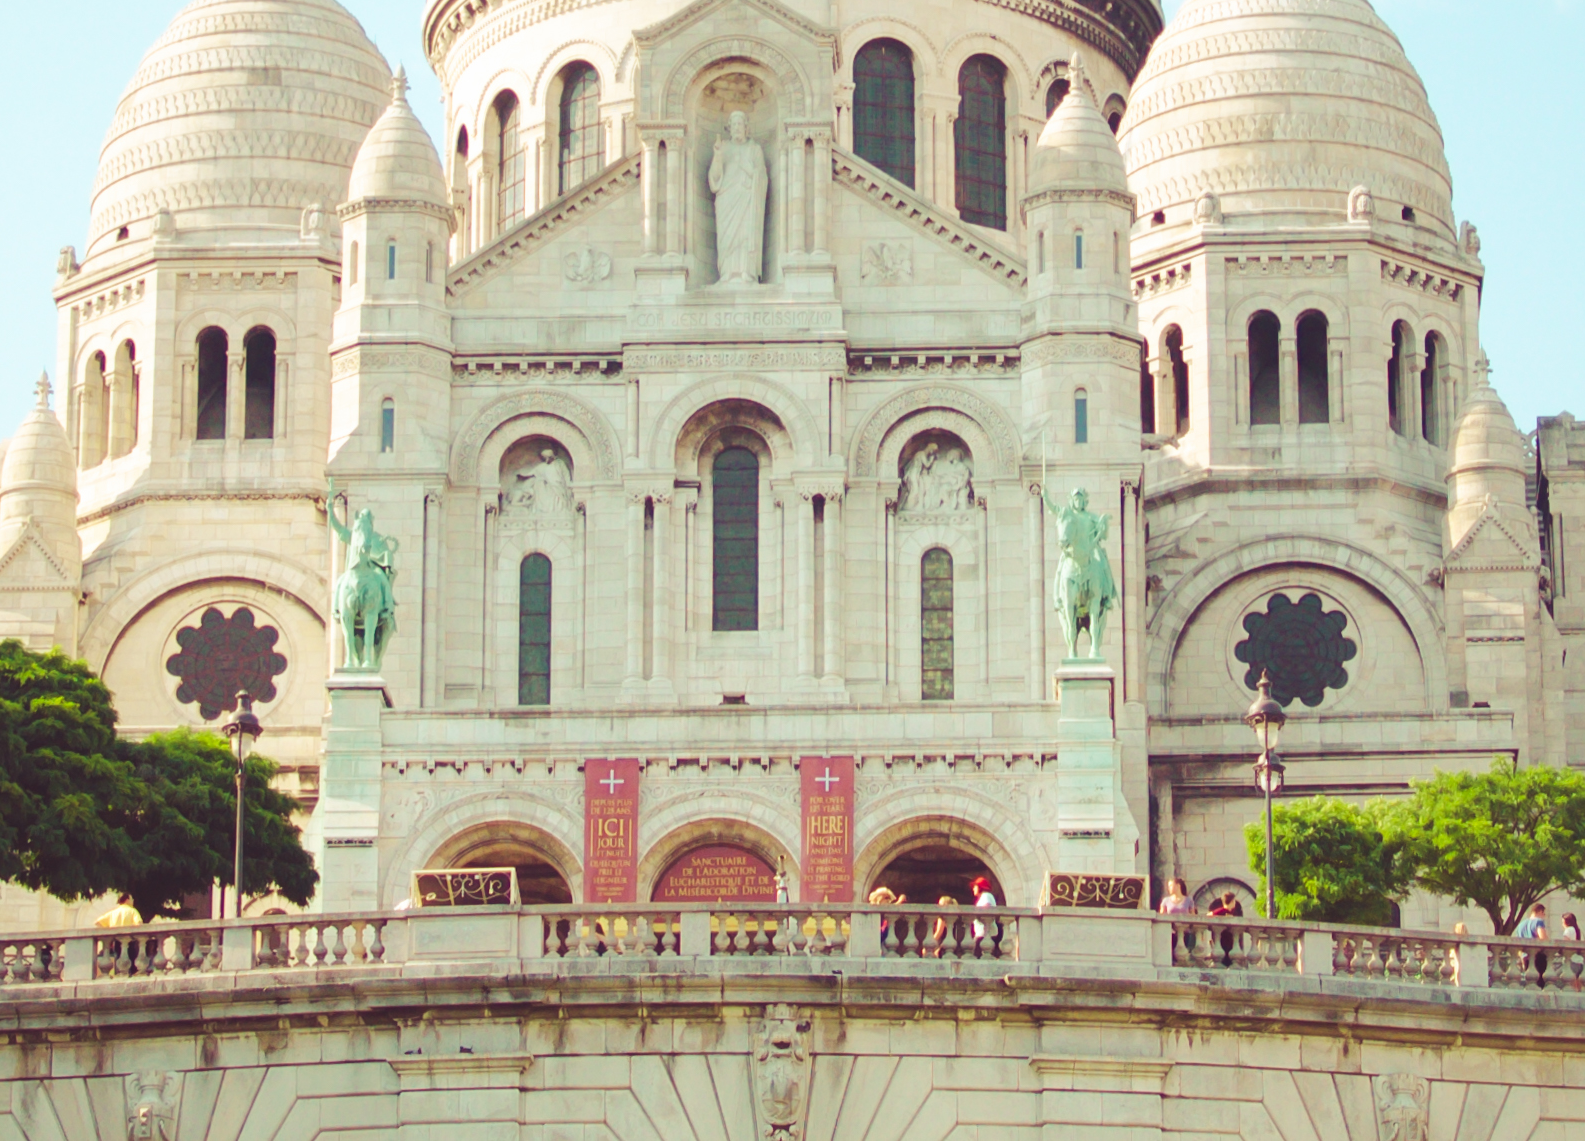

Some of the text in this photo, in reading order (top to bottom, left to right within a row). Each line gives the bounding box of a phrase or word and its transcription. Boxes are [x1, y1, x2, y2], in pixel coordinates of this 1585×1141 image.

[671, 312, 708, 327] JESU
[590, 798, 633, 807] DEPUIS PLUS
[590, 807, 600, 815] DE
[598, 818, 624, 837] ICI
[811, 815, 844, 834] HERE
[597, 837, 626, 849] JOUR
[811, 835, 843, 846] NIGHT
[745, 876, 755, 885] ET
[758, 876, 769, 885] DE
